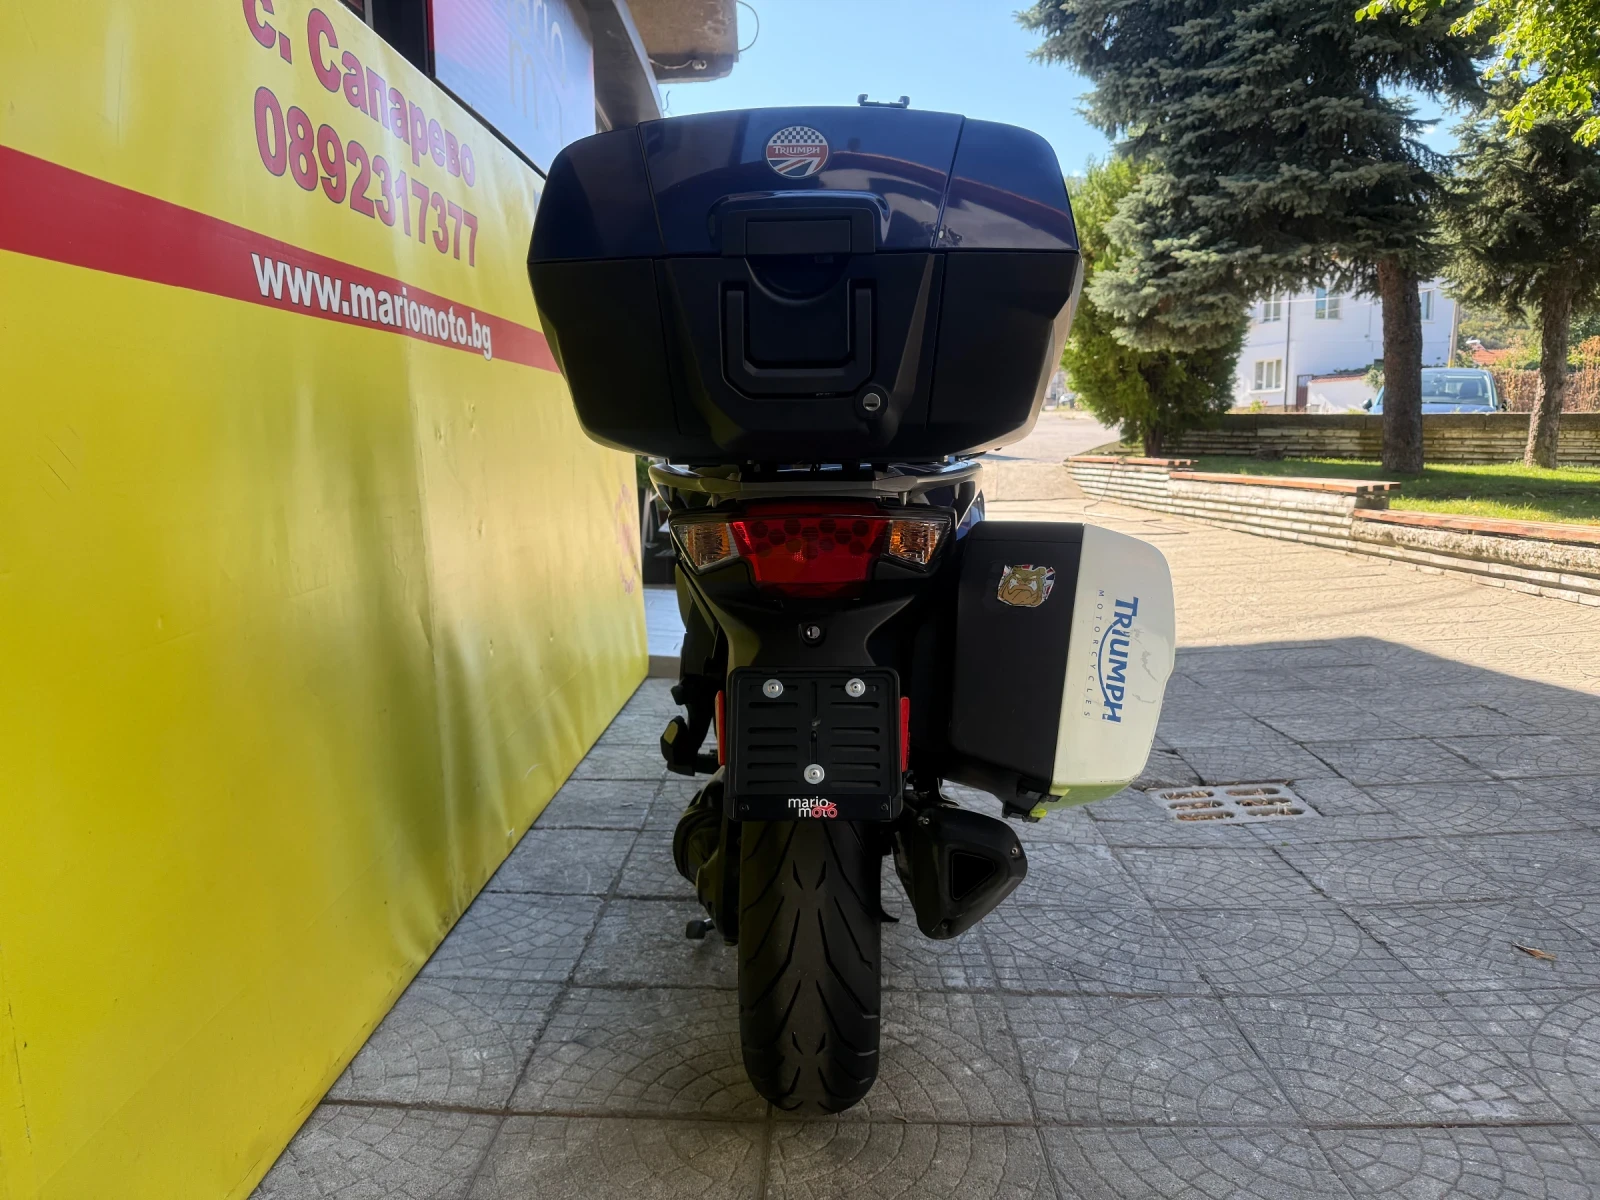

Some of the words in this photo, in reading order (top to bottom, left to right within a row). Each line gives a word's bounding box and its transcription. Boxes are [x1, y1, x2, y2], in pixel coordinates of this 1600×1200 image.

[307, 8, 476, 188] Сапарево
[773, 145, 820, 156] TRIUMPH
[253, 86, 478, 267] 0892317377
[251, 252, 493, 361] www.mariomoto.bg
[1083, 589, 1105, 717] MOTORCYCLES
[1098, 596, 1139, 723] TRIUMPH
[788, 796, 829, 809] mario
[798, 807, 838, 818] moto
